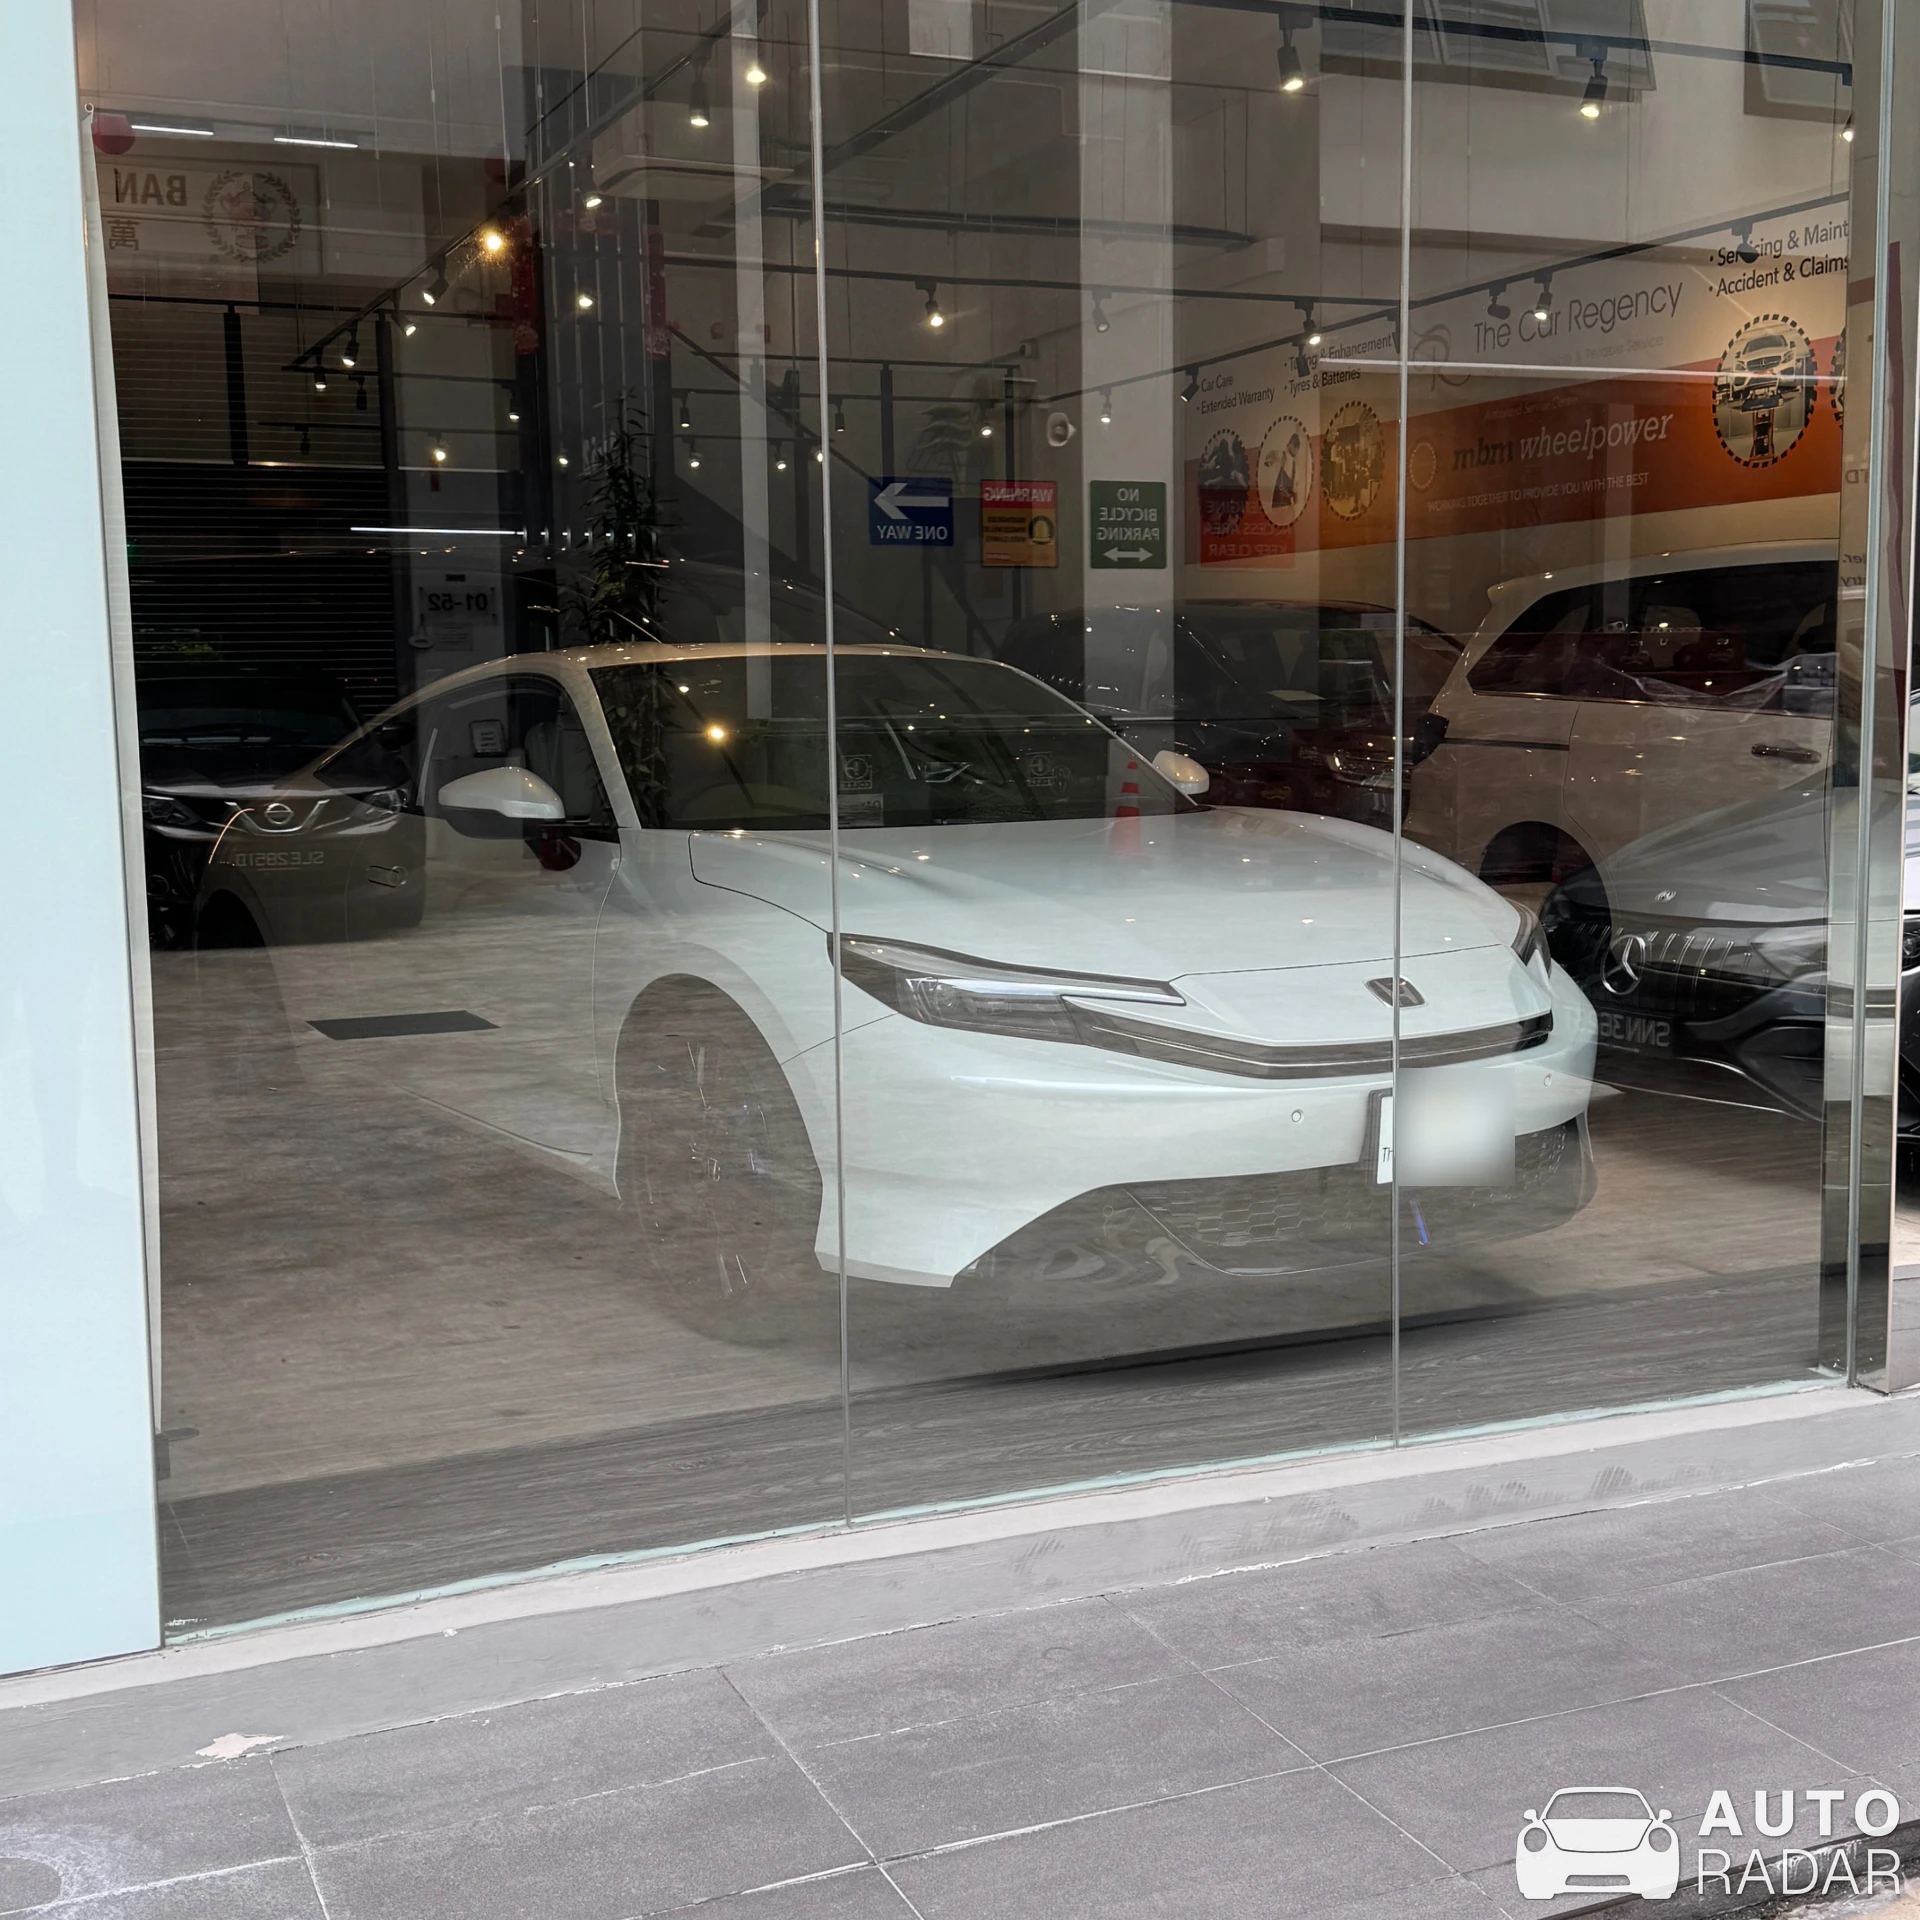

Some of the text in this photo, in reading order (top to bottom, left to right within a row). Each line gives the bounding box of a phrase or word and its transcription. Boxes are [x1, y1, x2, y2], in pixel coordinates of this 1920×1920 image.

[1717, 238, 1783, 267] Sercing
[1787, 229, 1800, 250] &
[1716, 268, 1780, 297] Accident
[1783, 262, 1795, 282] &
[1473, 281, 1684, 353] The Car Regency
[1329, 335, 1392, 359] Enhancement
[1200, 374, 1234, 392] Car Care
[1288, 366, 1362, 398] Tyres & Batteries
[1200, 387, 1275, 414] Extended Warranty
[1452, 413, 1674, 471] mbm wheelpower
[1427, 472, 1650, 513] WORKING TOGETHER TO PROVIDE YOU WITH THE BEST
